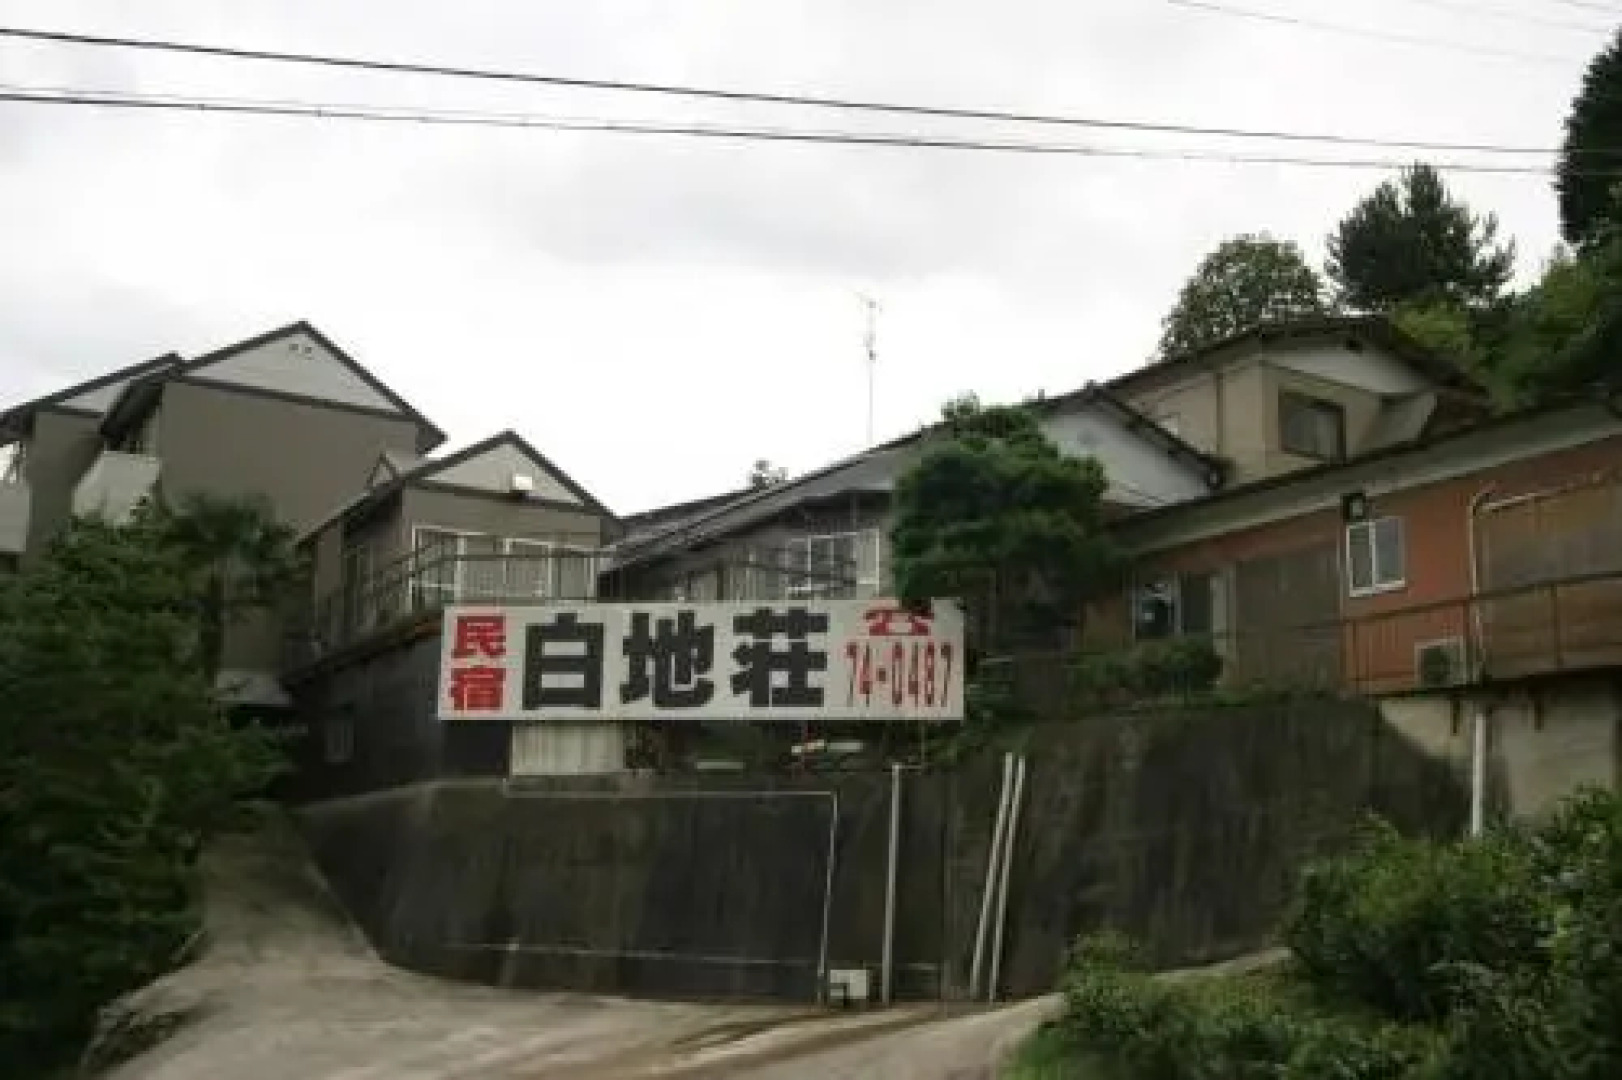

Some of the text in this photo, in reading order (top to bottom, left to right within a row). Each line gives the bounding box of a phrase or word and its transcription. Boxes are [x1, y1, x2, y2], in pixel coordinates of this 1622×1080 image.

[450, 614, 507, 711] 民宿
[522, 608, 828, 710] 白地荘
